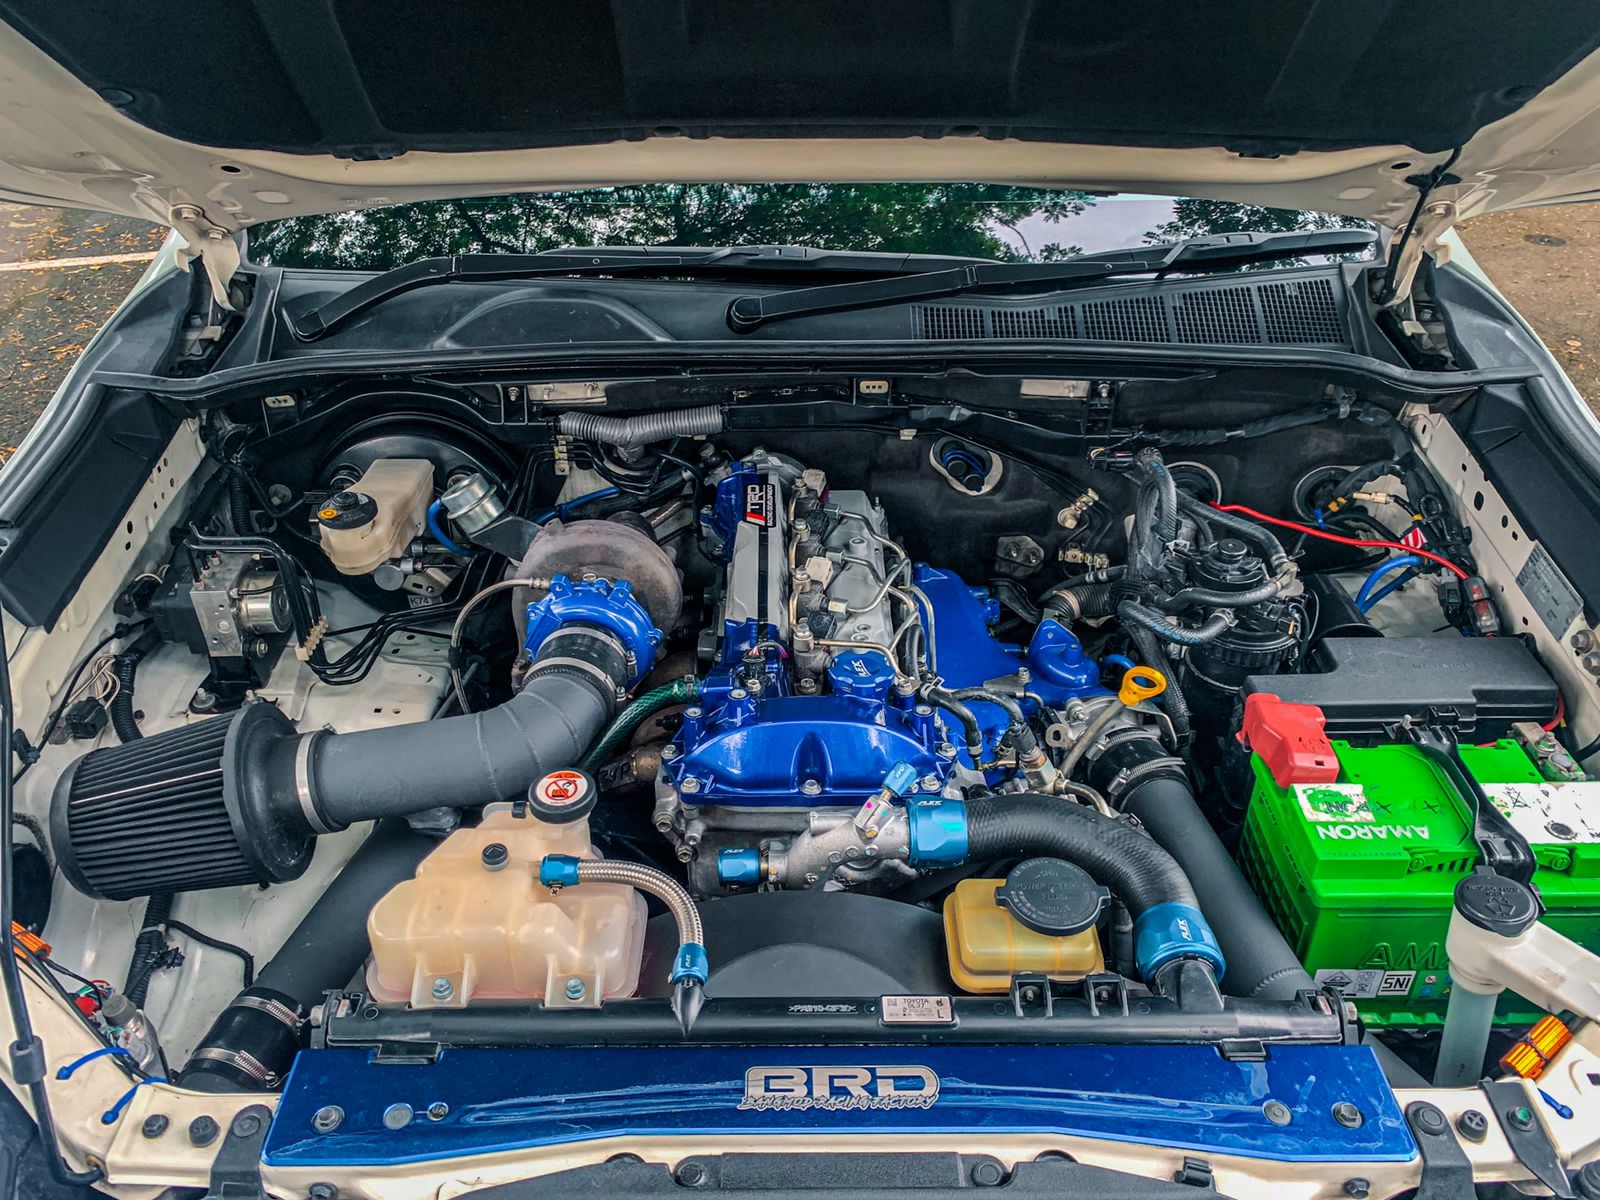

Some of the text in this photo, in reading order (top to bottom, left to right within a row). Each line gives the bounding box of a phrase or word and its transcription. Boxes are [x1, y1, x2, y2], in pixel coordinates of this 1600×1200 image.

[746, 484, 765, 513] TRD
[1316, 824, 1430, 840] AMARON
[1382, 977, 1412, 989] SNI
[745, 1066, 940, 1099] BRD
[813, 1095, 870, 1110] RACING
[870, 1094, 939, 1110] FACTORY
